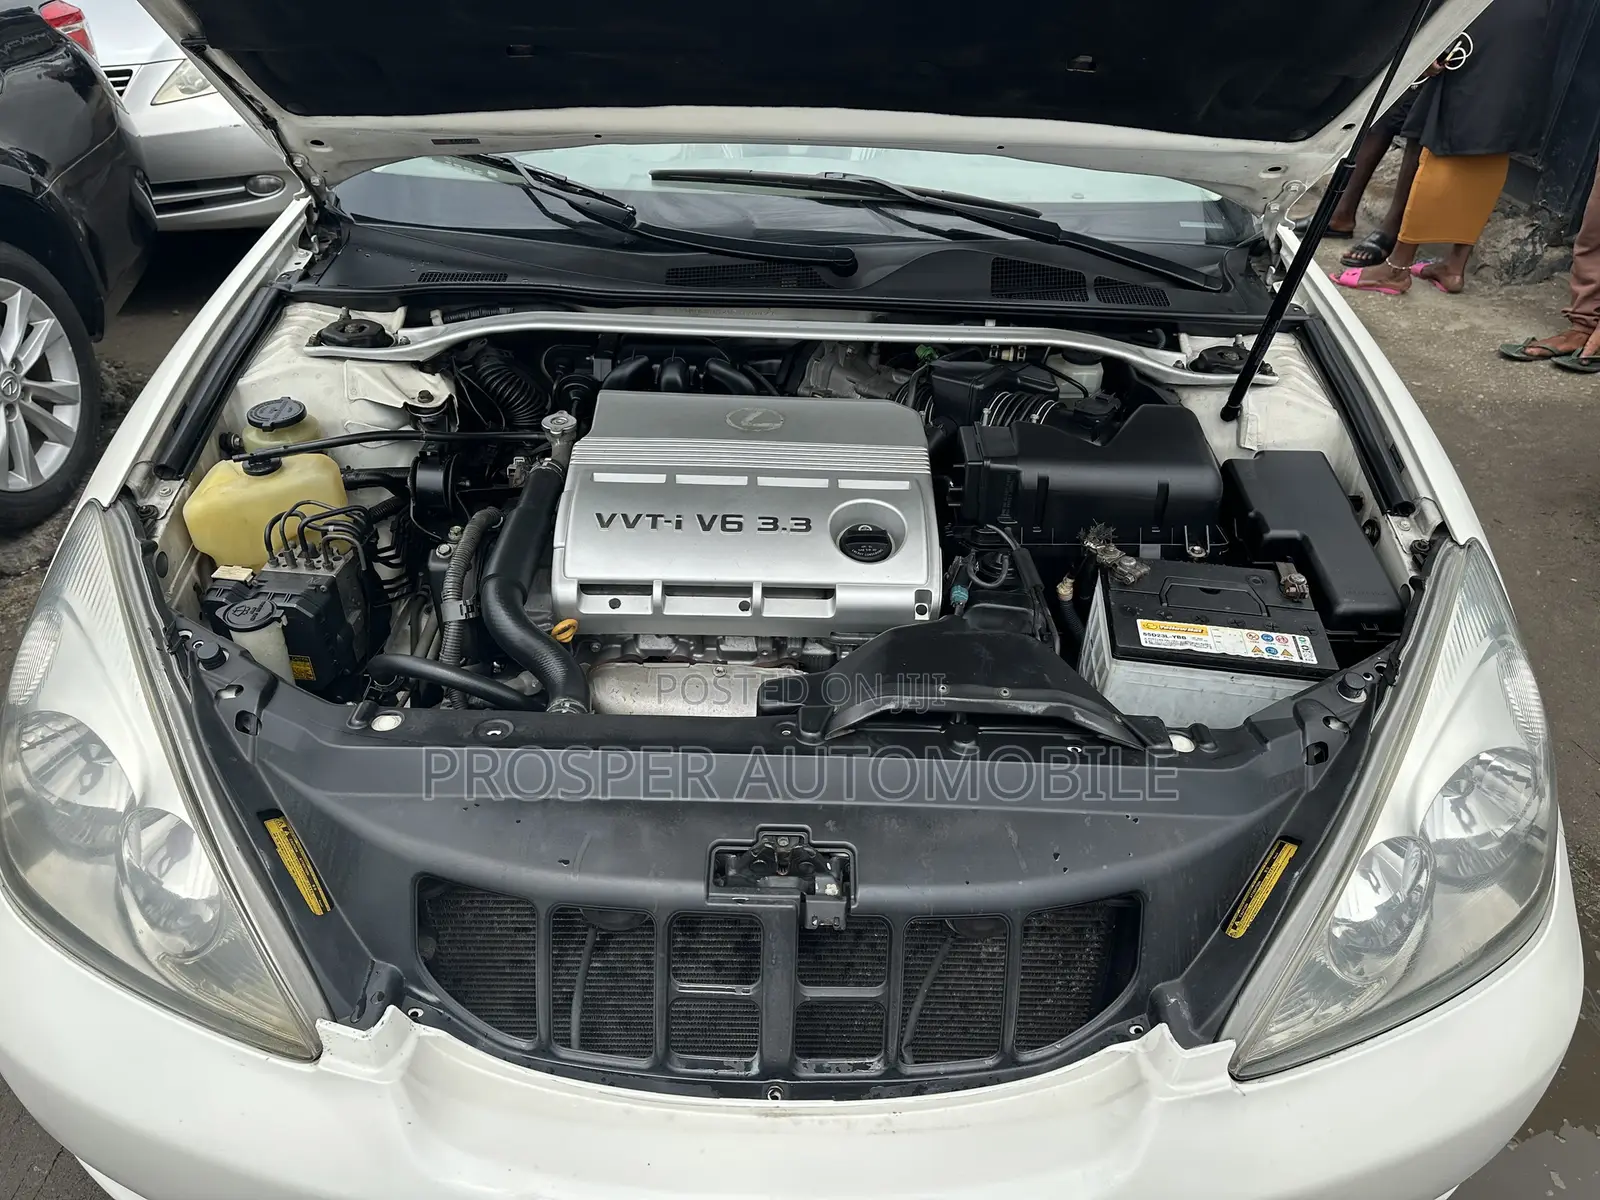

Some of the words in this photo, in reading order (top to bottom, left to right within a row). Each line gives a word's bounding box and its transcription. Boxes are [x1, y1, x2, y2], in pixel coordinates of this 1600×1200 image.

[593, 512, 684, 531] VVT-i
[695, 513, 744, 533] V6
[756, 515, 813, 534] 3.3
